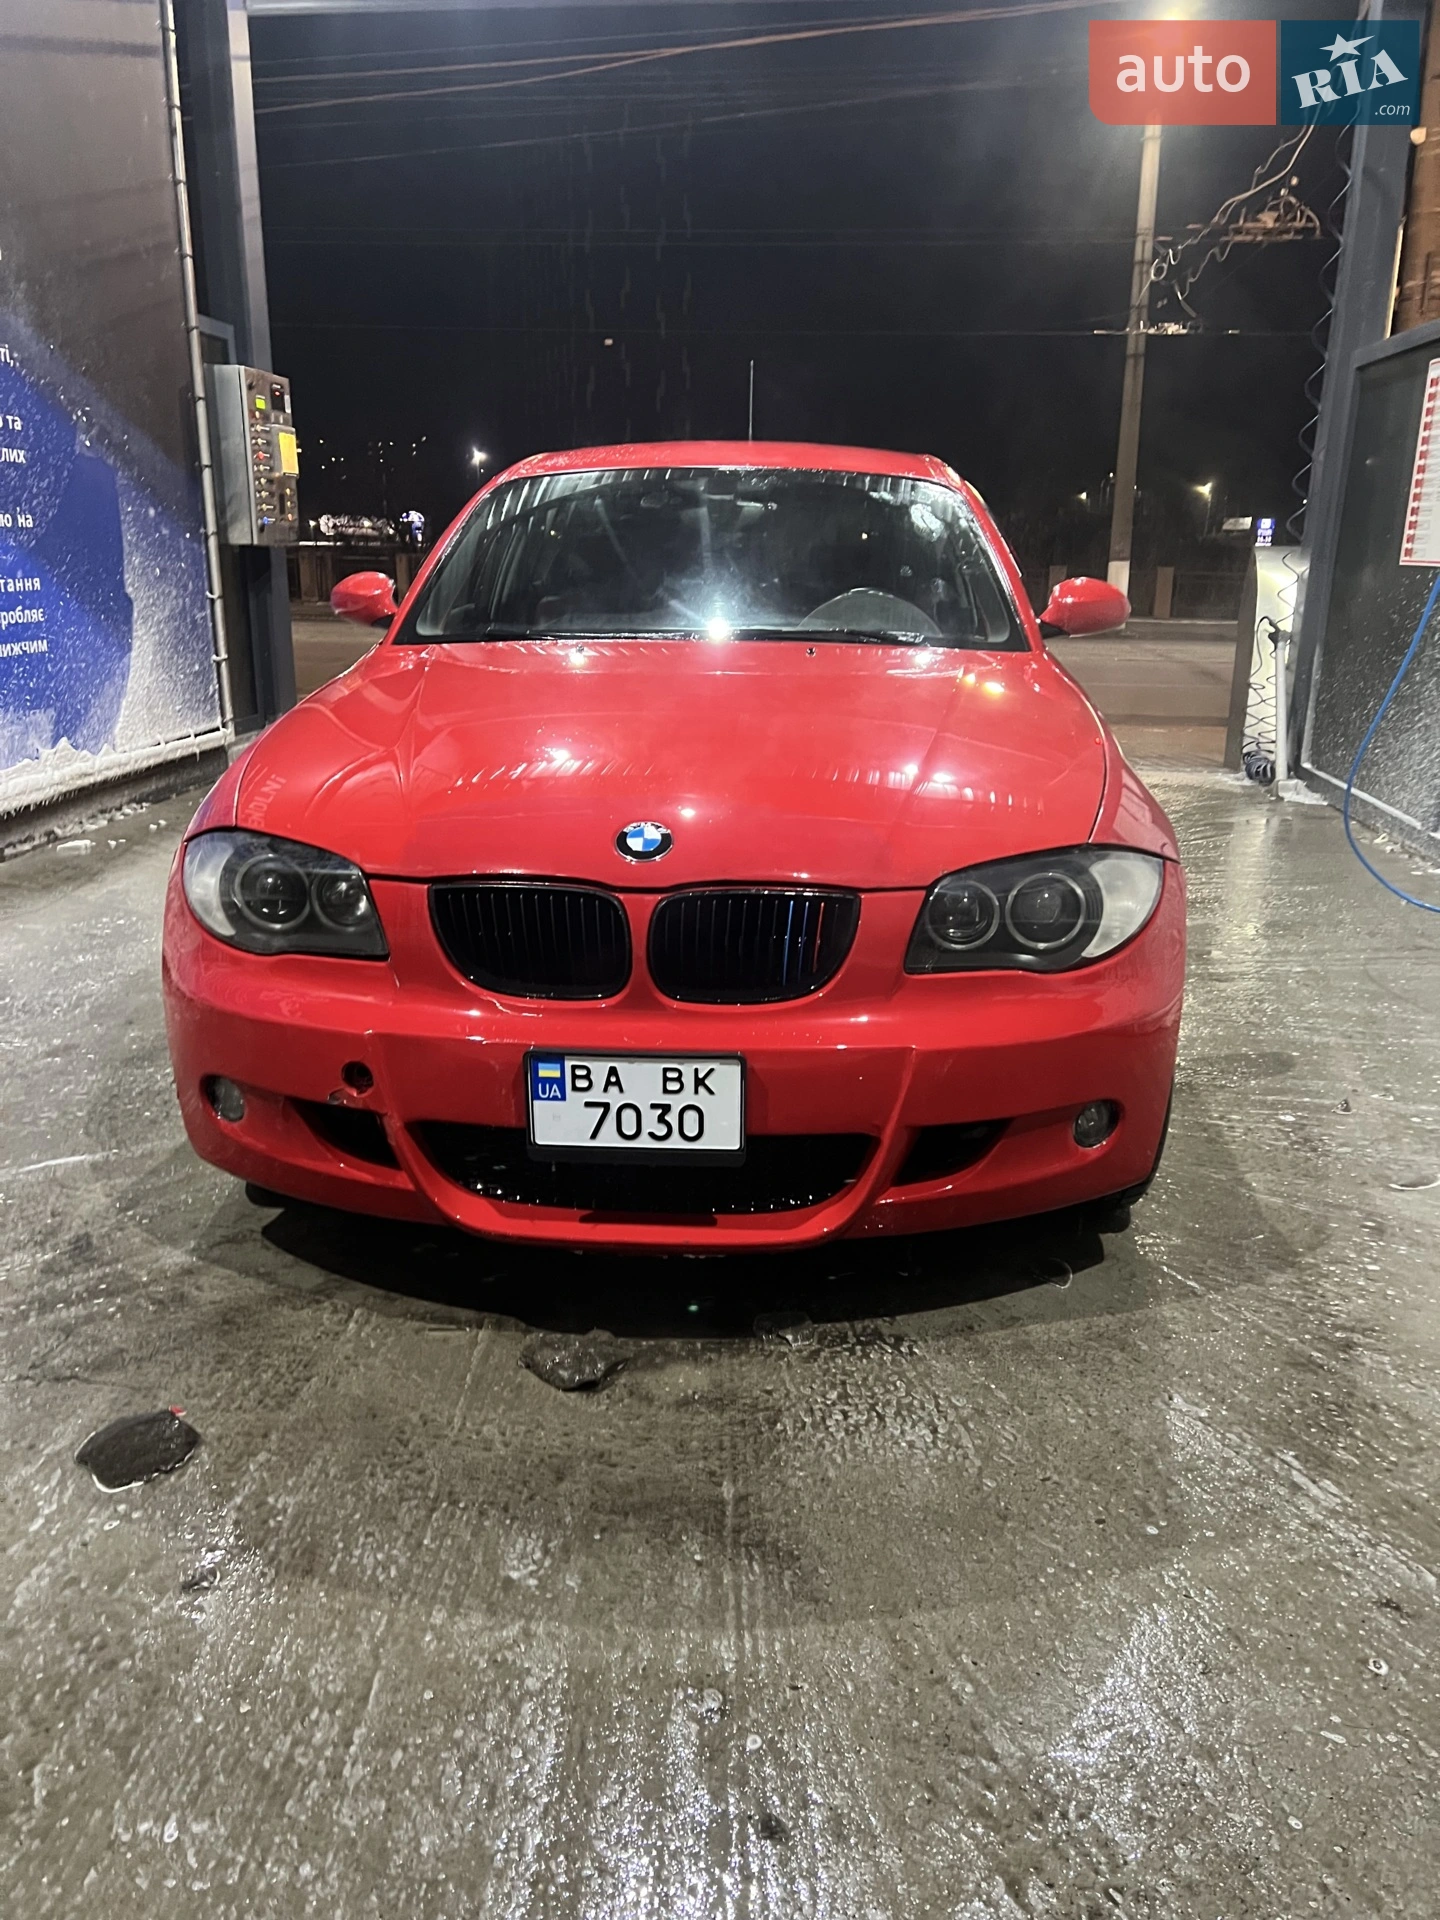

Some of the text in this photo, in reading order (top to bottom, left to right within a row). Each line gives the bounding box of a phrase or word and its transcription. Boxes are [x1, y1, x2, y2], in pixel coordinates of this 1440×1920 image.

[6, 415, 22, 431] та
[17, 514, 33, 528] на
[0, 577, 41, 593] тання
[1, 605, 45, 631] робляє
[0, 639, 48, 658] ижчим
[570, 1063, 716, 1096] BA BK
[538, 1083, 561, 1099] UA
[583, 1101, 705, 1142] 7030
